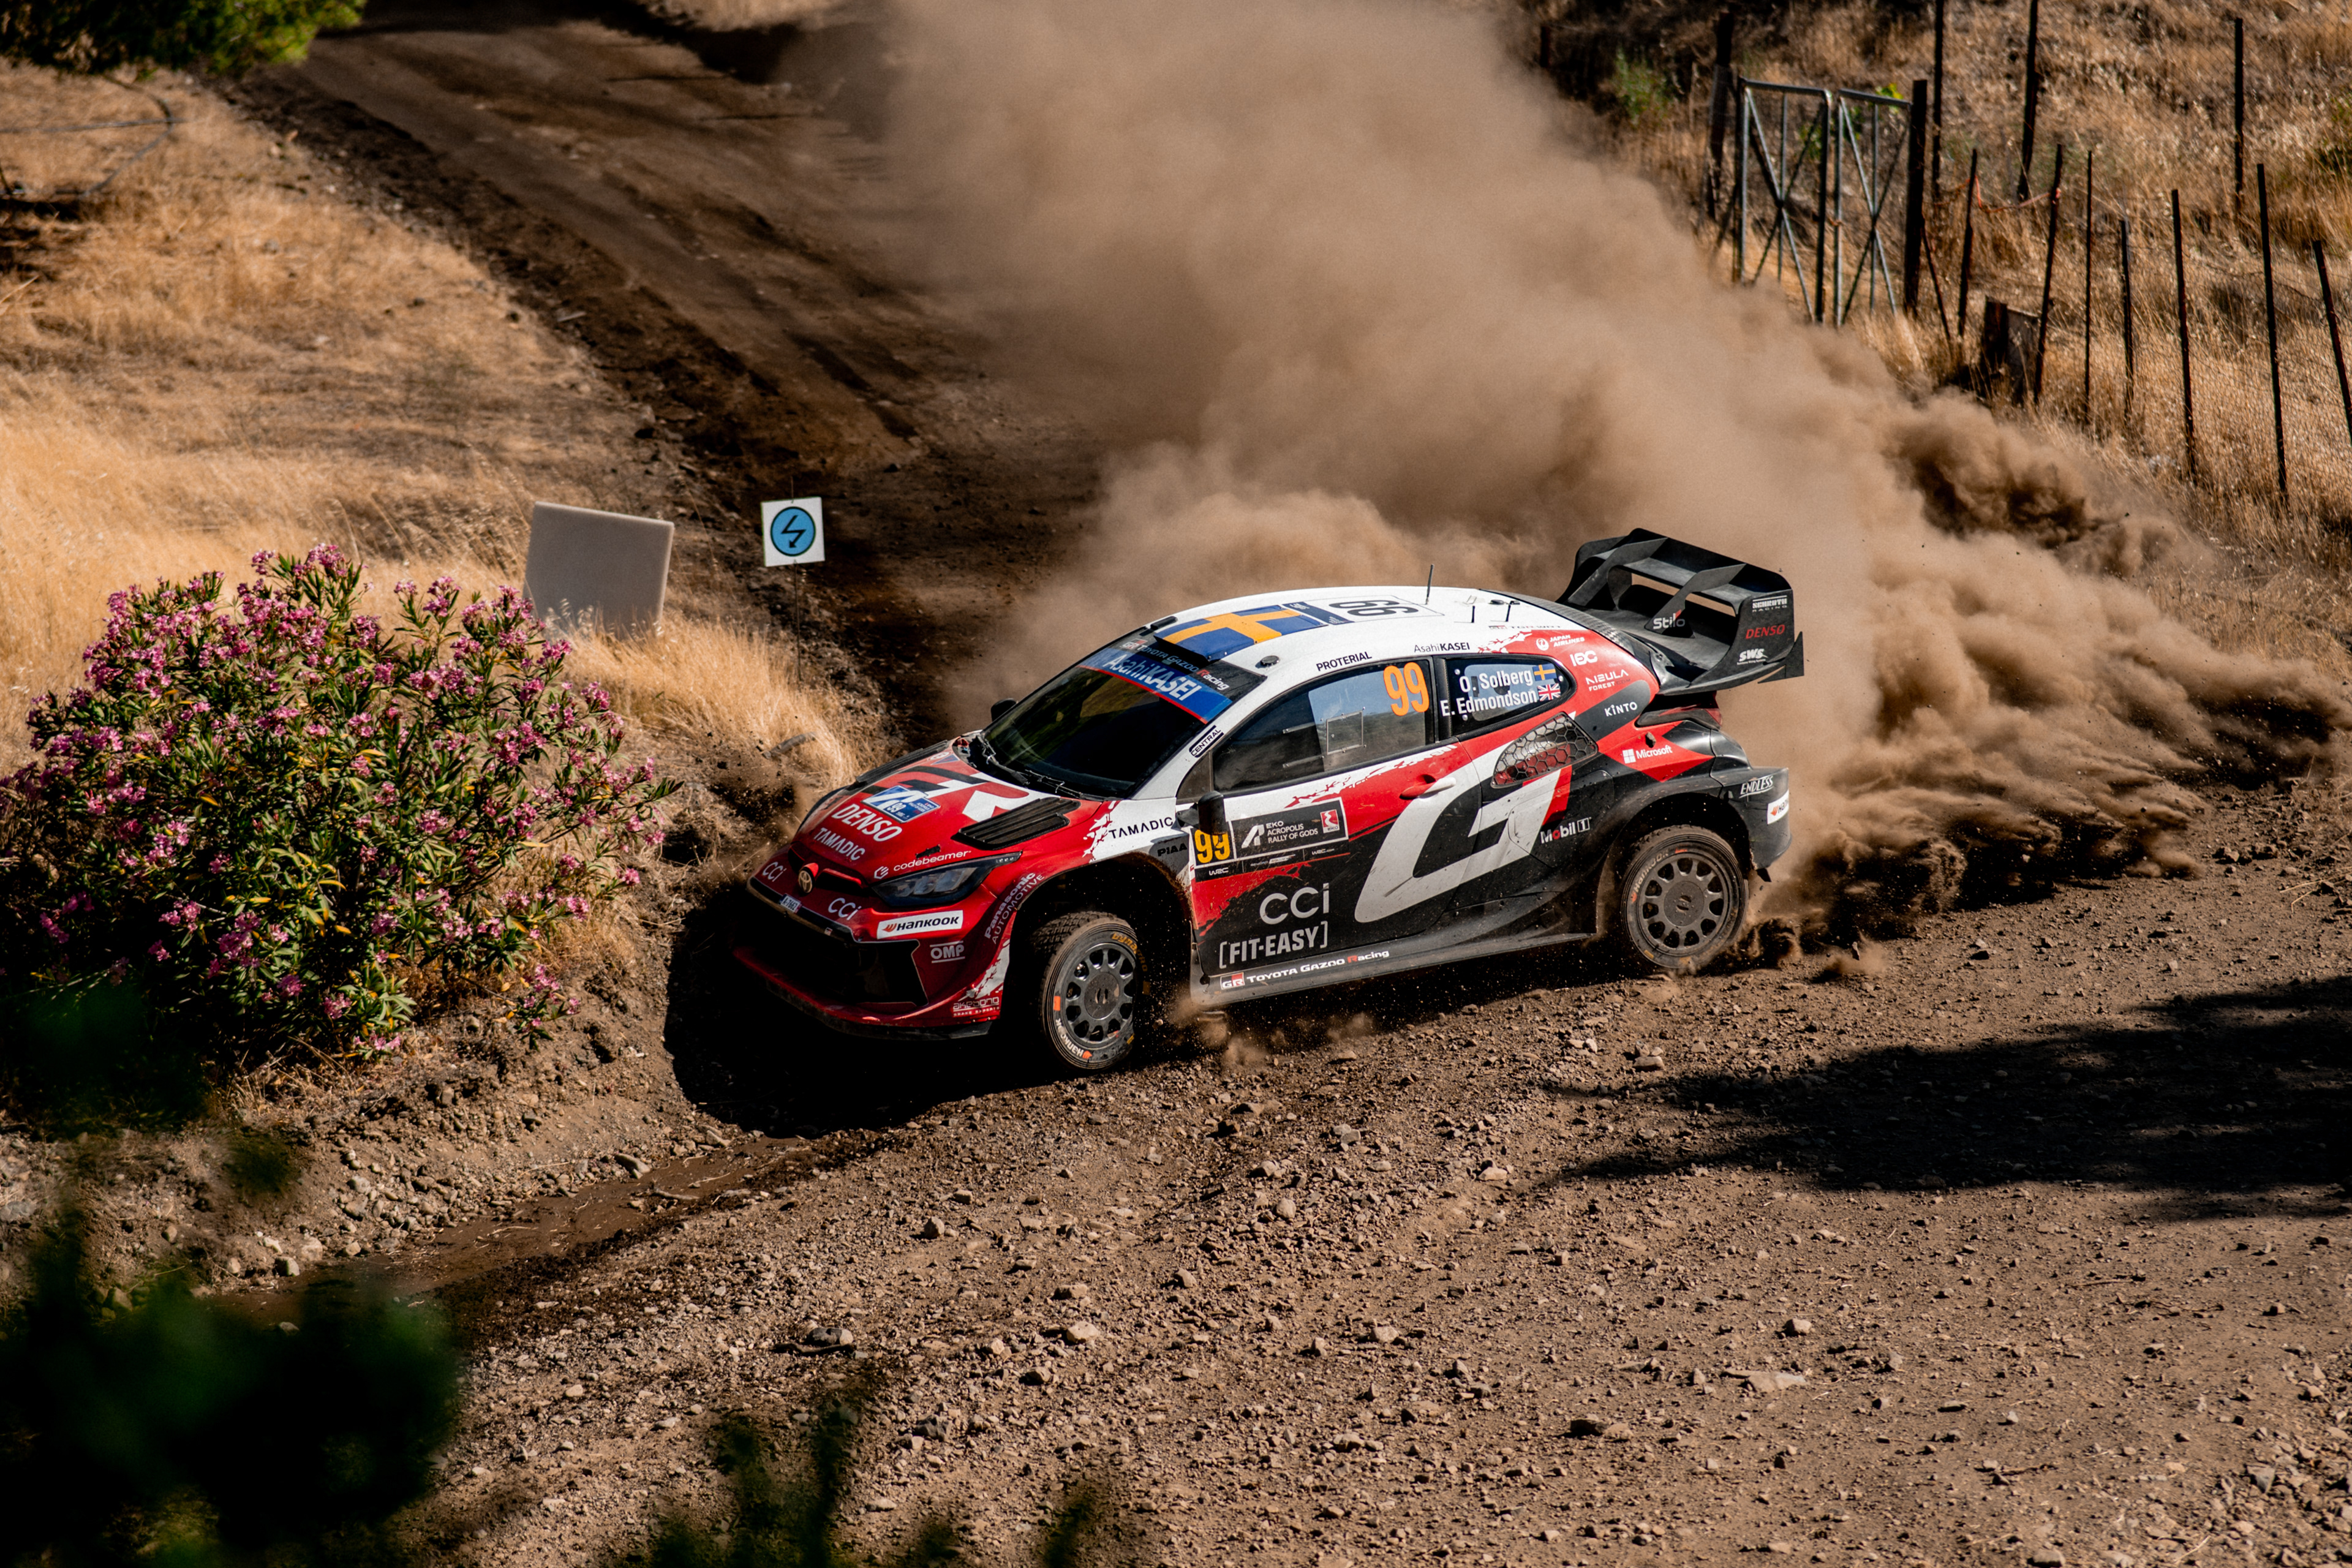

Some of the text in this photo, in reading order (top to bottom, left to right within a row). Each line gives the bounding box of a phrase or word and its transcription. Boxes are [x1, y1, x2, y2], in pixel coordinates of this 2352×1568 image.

[1653, 612, 1686, 630] Stilo
[1745, 624, 1785, 639] DENSO
[1414, 642, 1470, 653] AsahiKASEI
[1553, 636, 1585, 647] AIRLINES
[1316, 651, 1373, 671] PROTERIAL
[1739, 648, 1766, 662] SWS
[1137, 644, 1169, 658] TOYOTA
[1166, 654, 1199, 673] GAZOO
[1196, 669, 1230, 690] Racing
[1382, 662, 1430, 717] 99
[1459, 670, 1534, 693] O. Solberg
[1440, 690, 1538, 717] E. Edmondson
[1190, 729, 1221, 756] CENTRAL
[1635, 744, 1673, 760] Microsoft
[1740, 775, 1773, 794] ENDLESS
[831, 804, 902, 842] DENSO
[1108, 816, 1174, 839] TAMADIC
[1266, 820, 1284, 829] EKO
[1267, 823, 1304, 837] ACROPOLIS
[1540, 821, 1576, 843] Mobil
[813, 827, 865, 861] TAMADIC
[1268, 834, 1287, 843] RALLY
[1299, 828, 1318, 837] GODS
[1157, 843, 1188, 857] PIAA
[1194, 829, 1231, 864] 99
[893, 850, 970, 872] codebeamer
[1208, 867, 1229, 876] WRC
[984, 872, 1036, 939] Panasonic
[992, 874, 1045, 944] AUTOMOTIVE
[930, 944, 965, 960] OMP
[1221, 950, 1390, 989] GR TOYOTA GAZOO Racing
